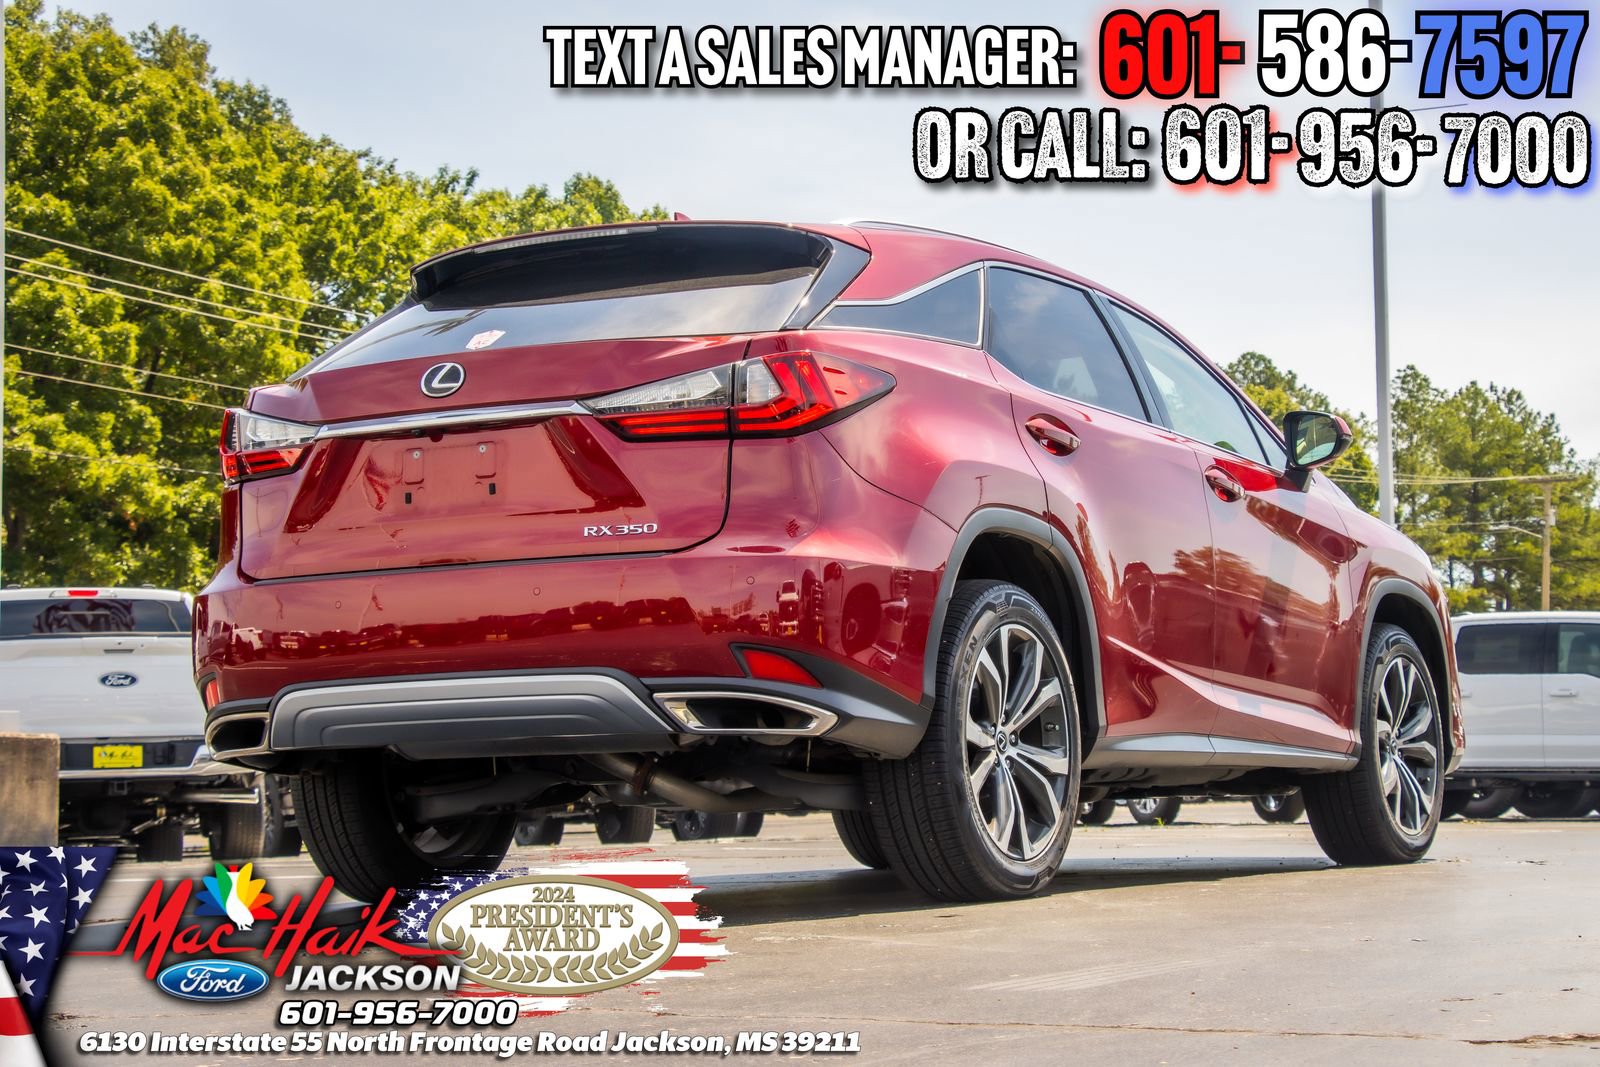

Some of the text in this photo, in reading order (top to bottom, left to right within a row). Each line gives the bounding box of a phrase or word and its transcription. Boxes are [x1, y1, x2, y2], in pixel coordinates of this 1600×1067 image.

[583, 523, 658, 537] RX 350
[104, 674, 132, 686] Ford
